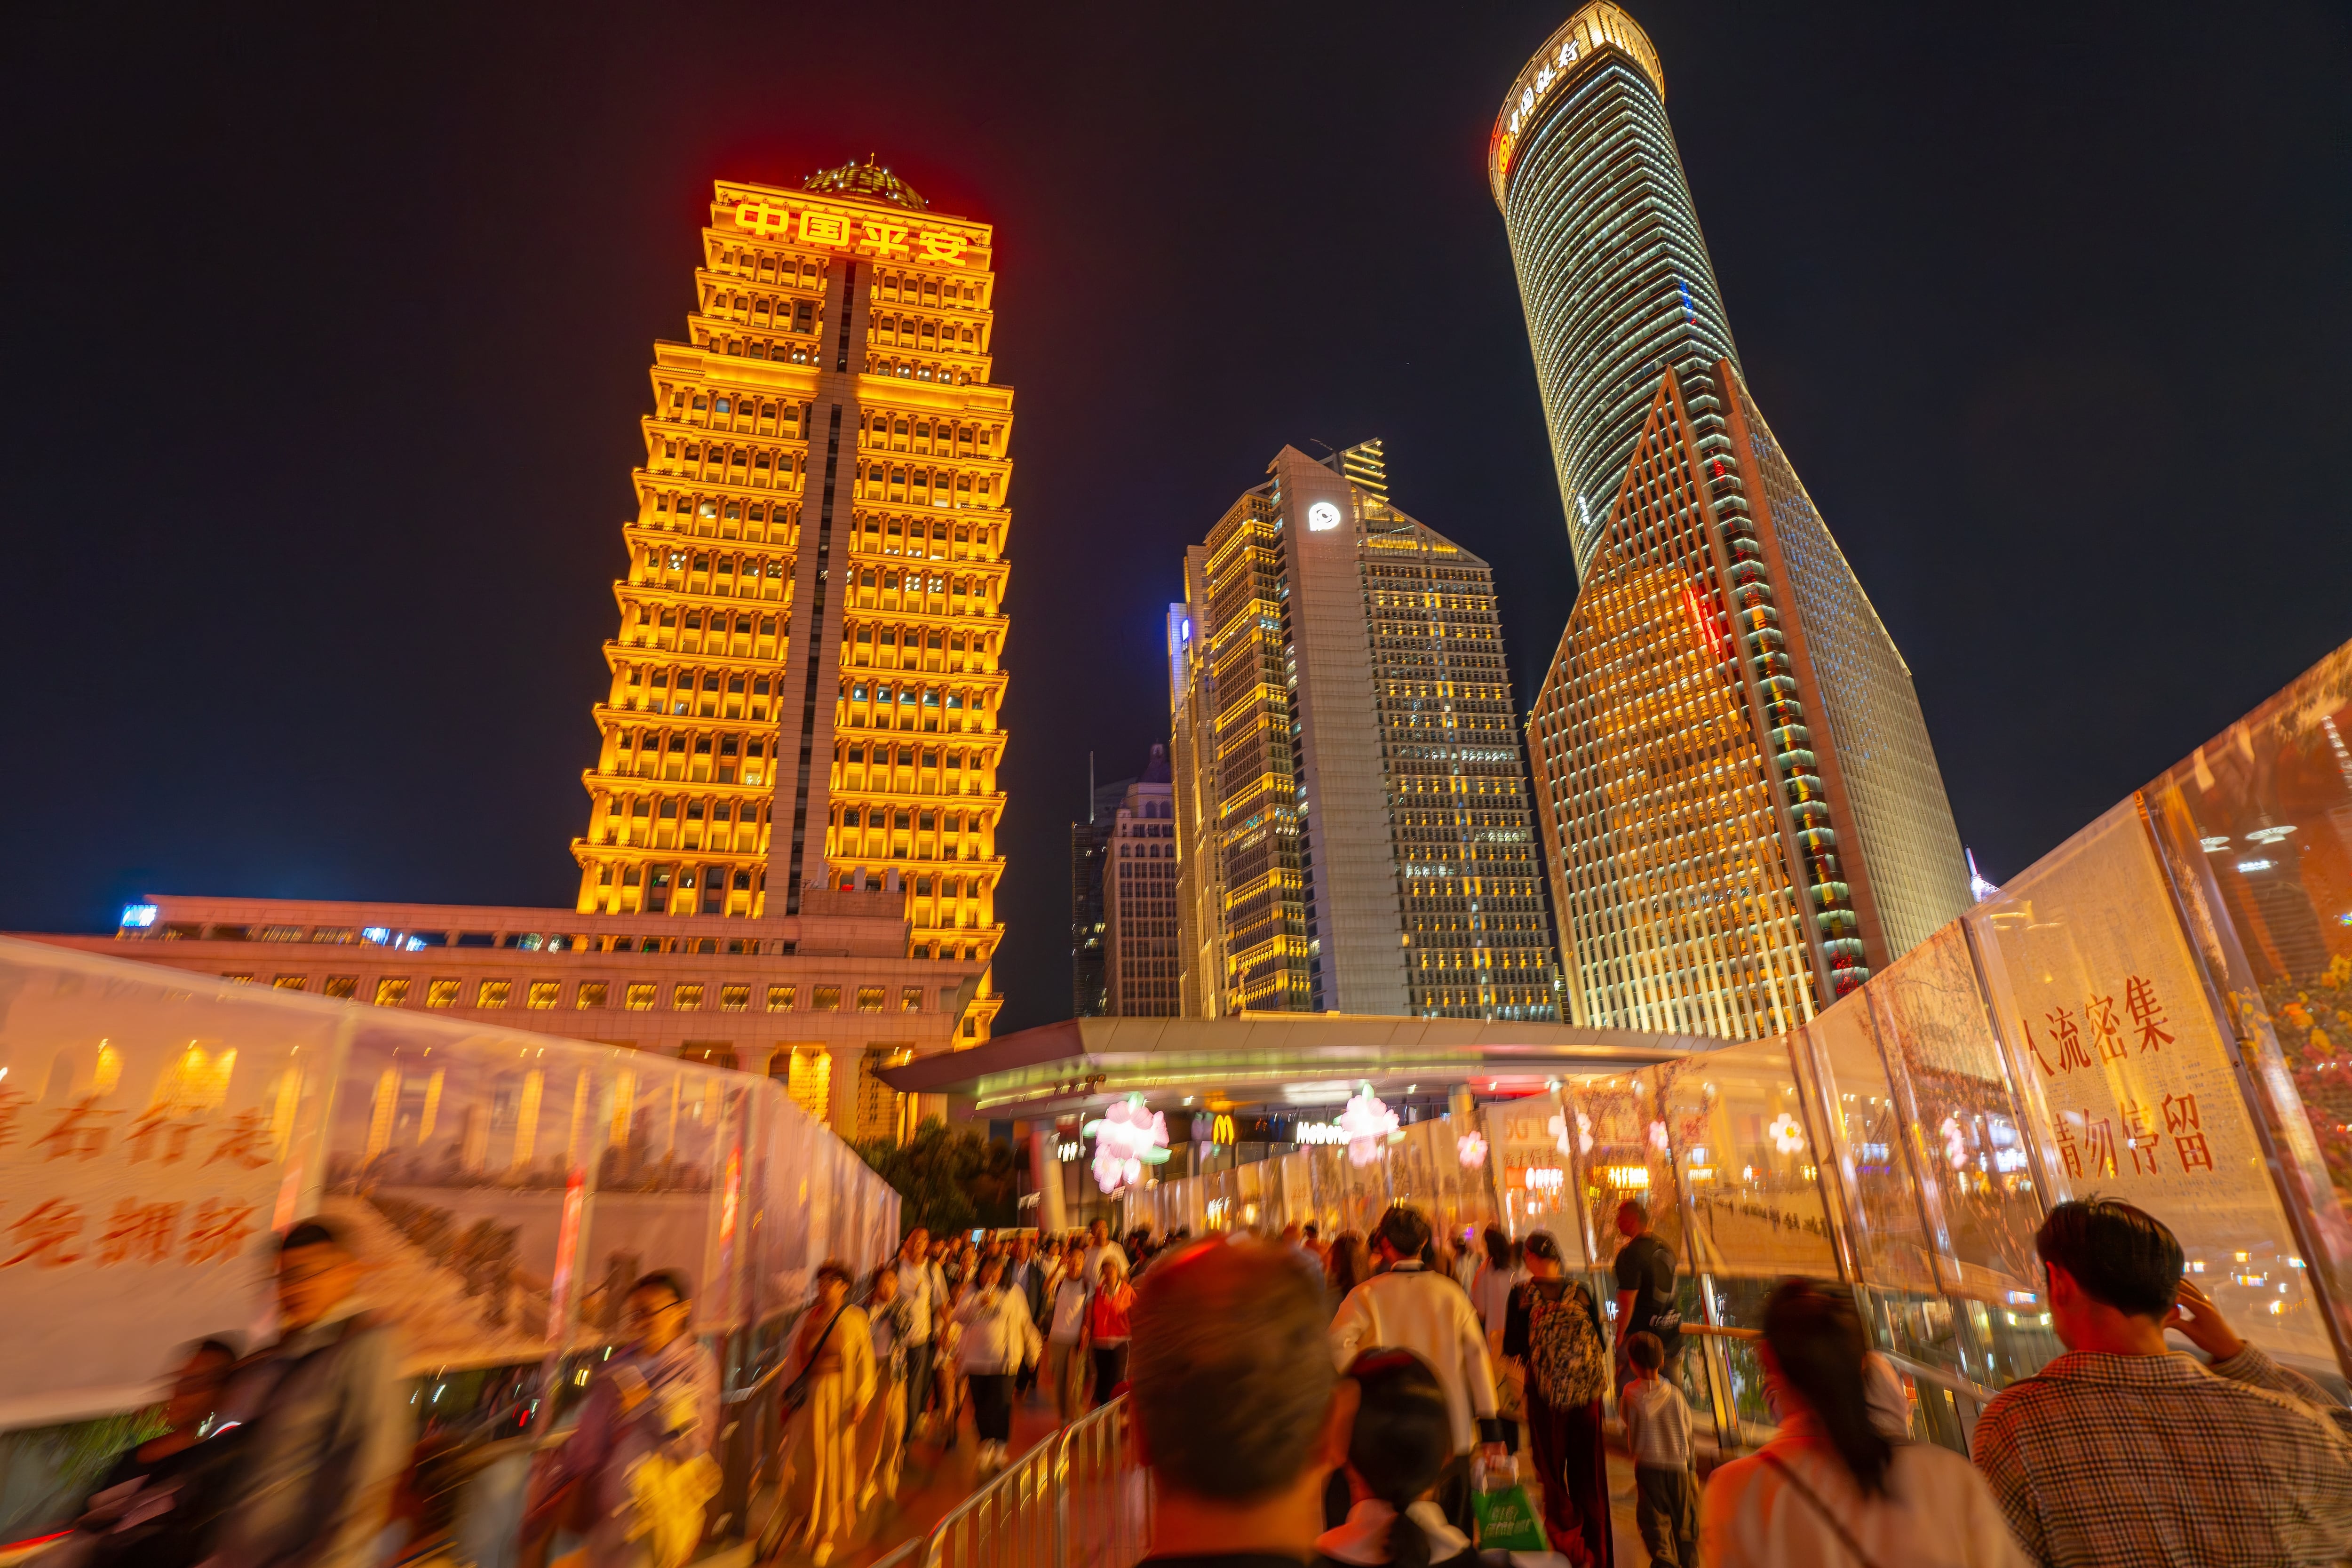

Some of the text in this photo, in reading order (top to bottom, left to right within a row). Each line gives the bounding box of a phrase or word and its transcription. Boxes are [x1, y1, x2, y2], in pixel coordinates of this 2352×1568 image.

[735, 203, 968, 266] 中国平安
[2024, 975, 2175, 1084] 人流密集
[2042, 1092, 2213, 1179] 请勿停留
